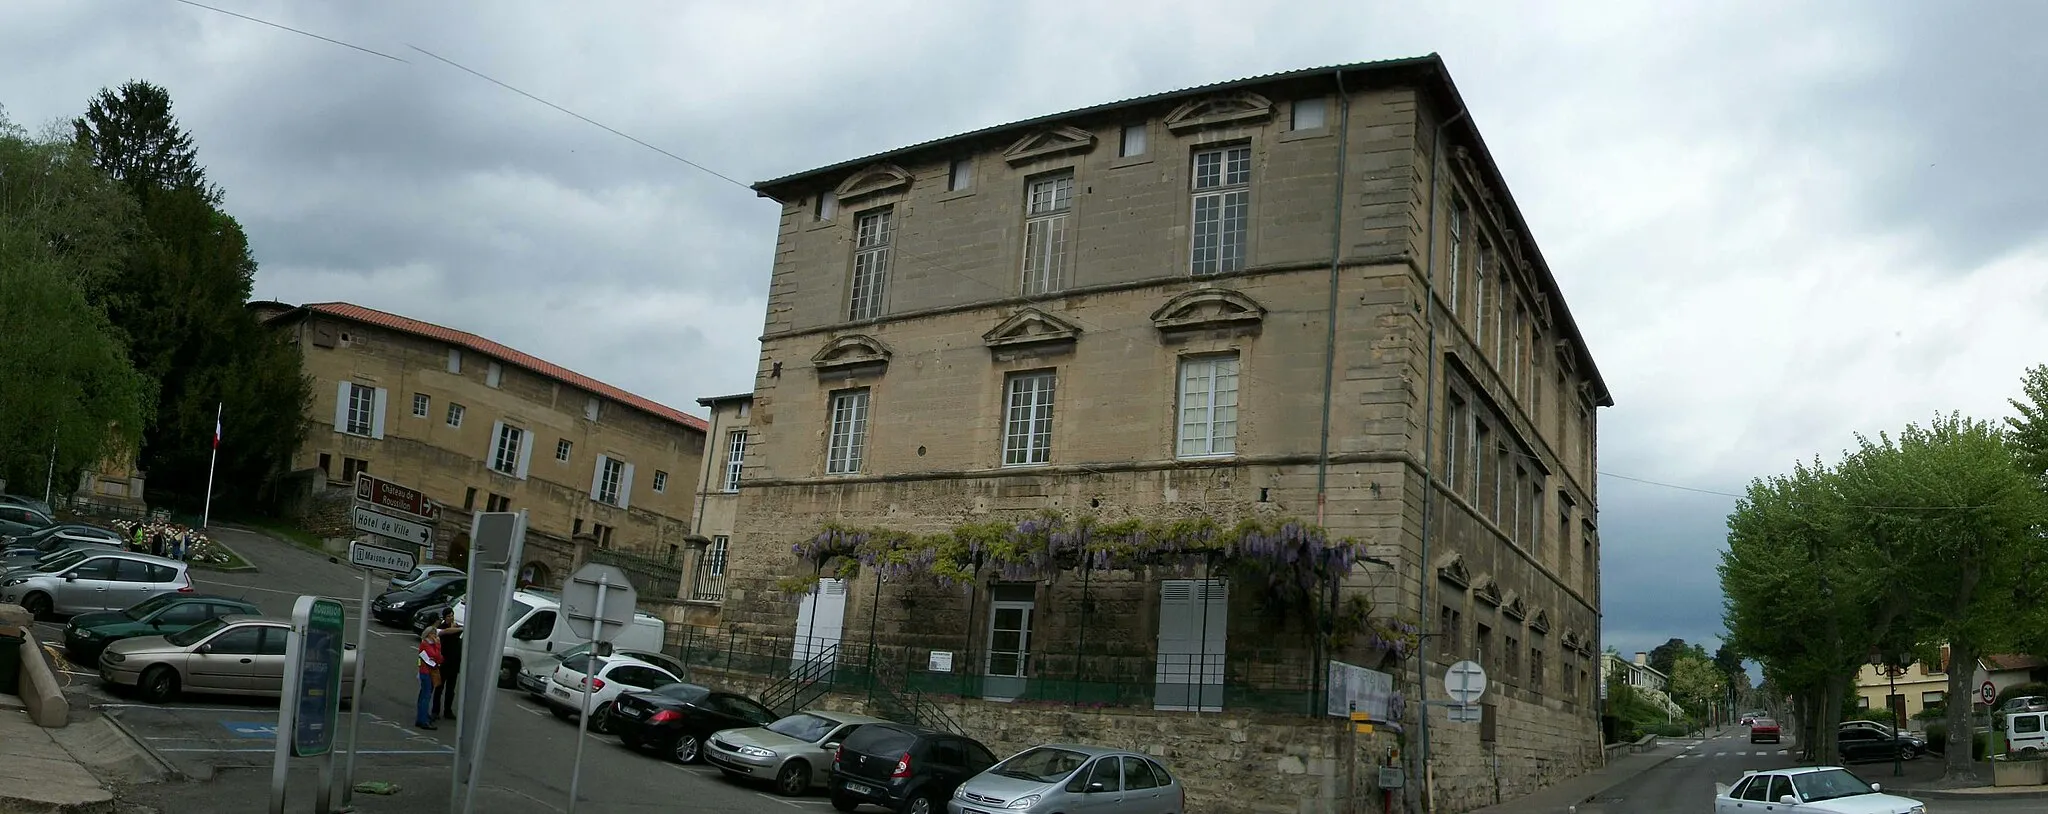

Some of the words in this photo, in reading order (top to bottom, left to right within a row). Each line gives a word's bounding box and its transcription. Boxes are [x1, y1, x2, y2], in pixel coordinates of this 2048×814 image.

[381, 483, 405, 497] Château
[406, 491, 414, 500] de
[383, 495, 410, 511] Roussillon
[358, 514, 378, 528] Hôtel
[382, 520, 390, 531] de
[394, 523, 410, 536] Ville
[365, 551, 386, 564] Maison
[388, 557, 394, 565] de
[396, 558, 410, 569] Pays
[1984, 687, 1992, 698] 30
